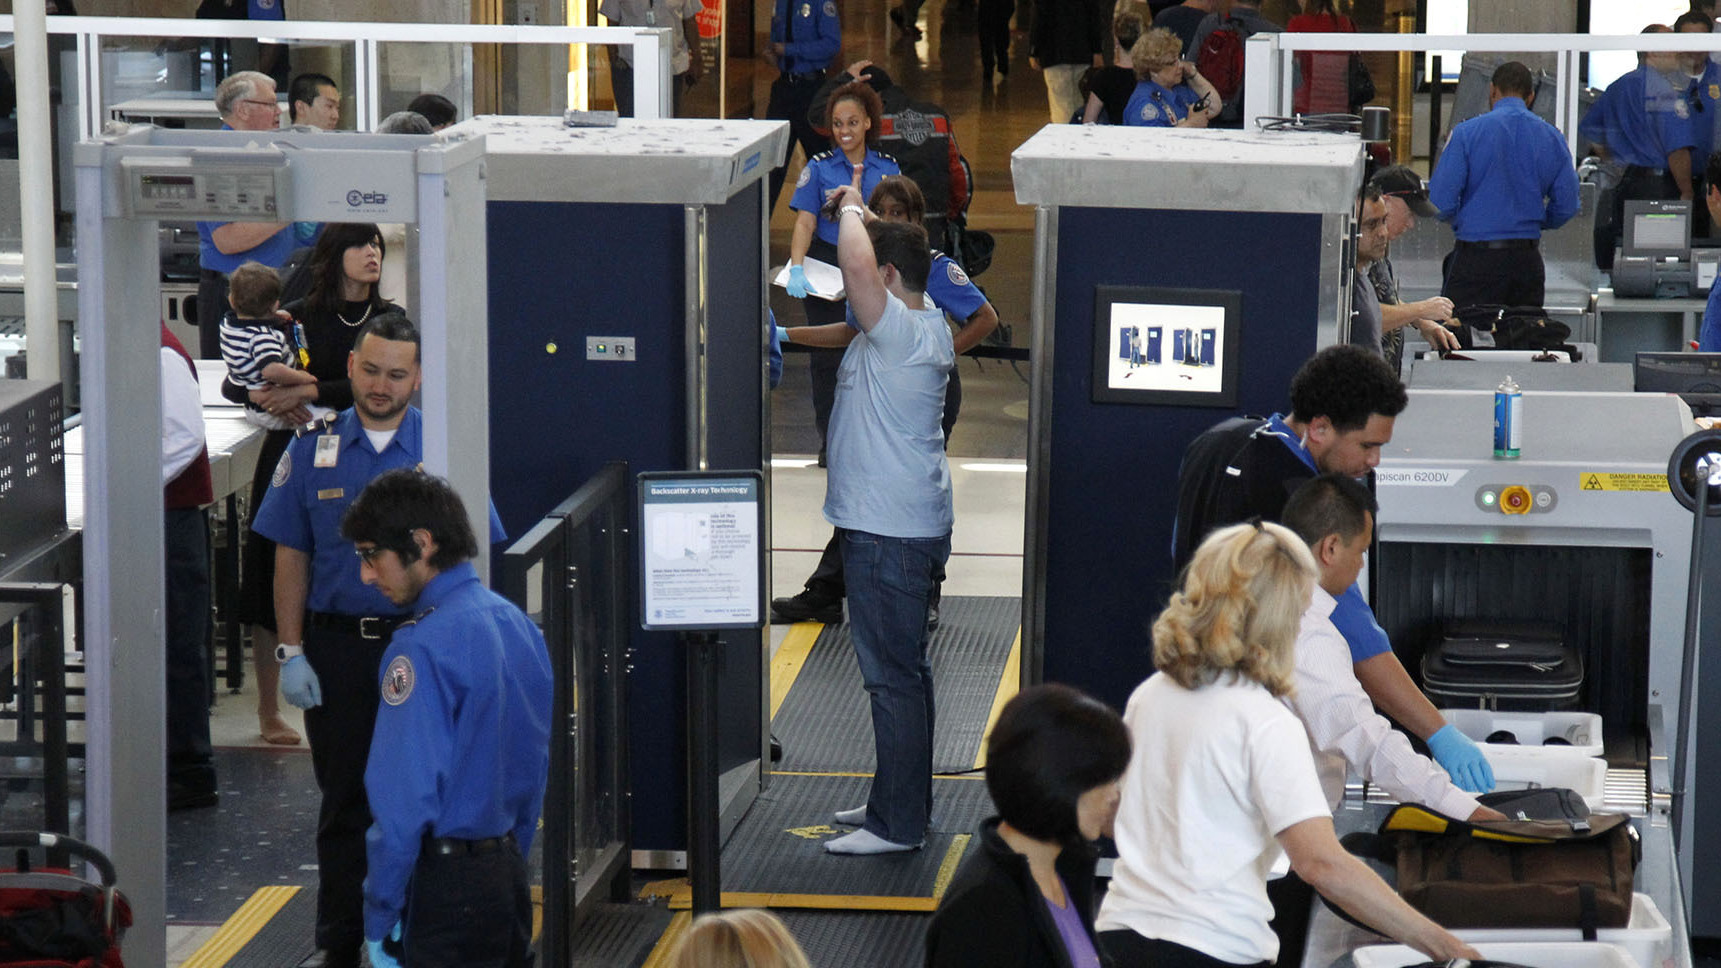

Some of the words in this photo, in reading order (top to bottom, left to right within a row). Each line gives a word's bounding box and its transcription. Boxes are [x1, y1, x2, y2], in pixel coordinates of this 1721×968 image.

[1376, 471, 1411, 482] apiscan
[1414, 471, 1449, 482] 620DV
[651, 487, 690, 495] Backscatter
[690, 487, 709, 496] X-ray
